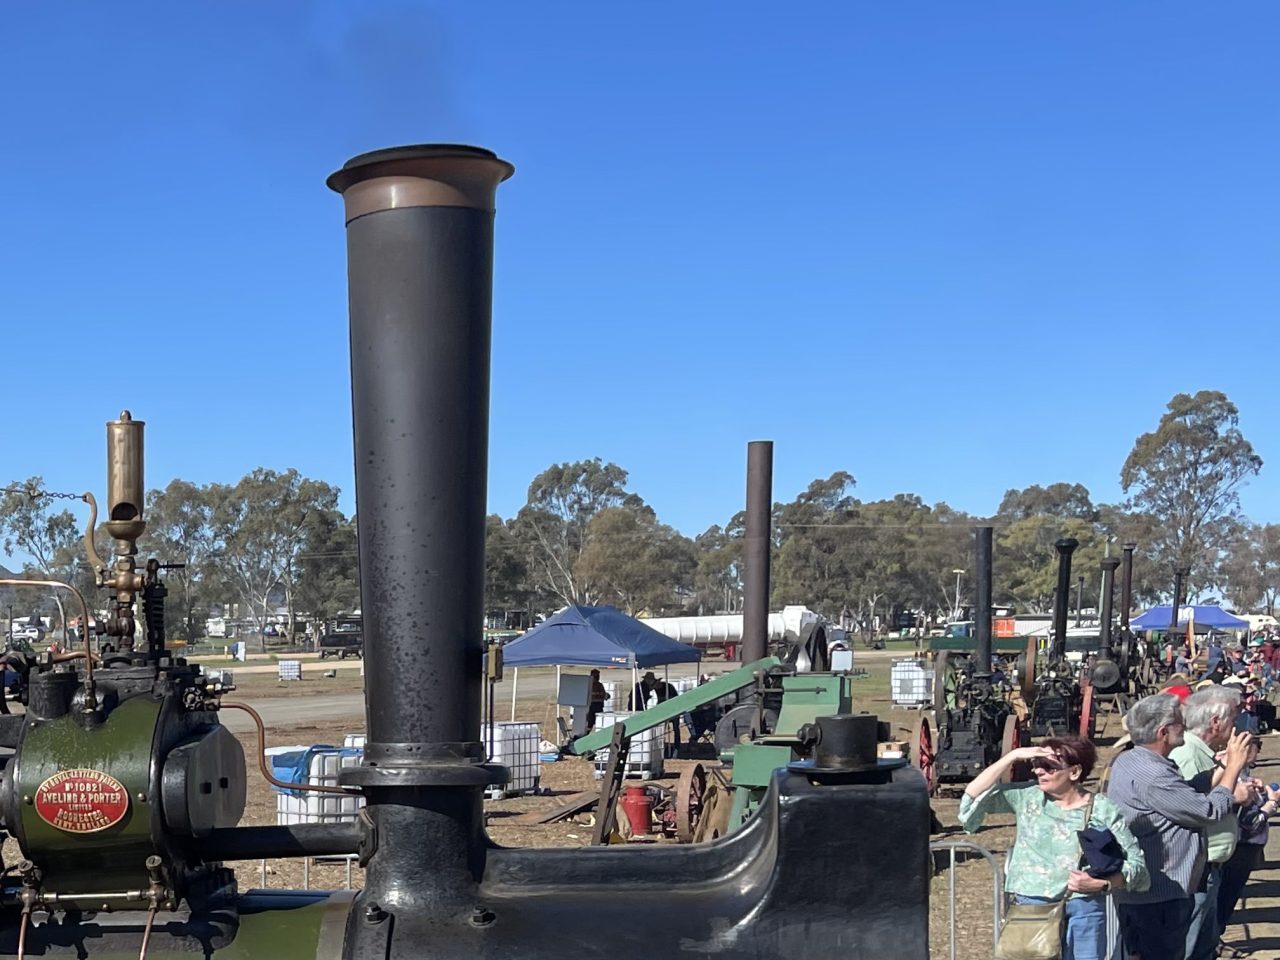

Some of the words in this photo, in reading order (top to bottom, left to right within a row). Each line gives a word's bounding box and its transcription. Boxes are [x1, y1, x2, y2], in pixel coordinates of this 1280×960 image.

[50, 772, 70, 788] ROYAL
[42, 792, 78, 804] AVELING
[80, 793, 87, 804] &
[88, 793, 121, 804] PORTER
[57, 808, 104, 823] ROCHESTER
